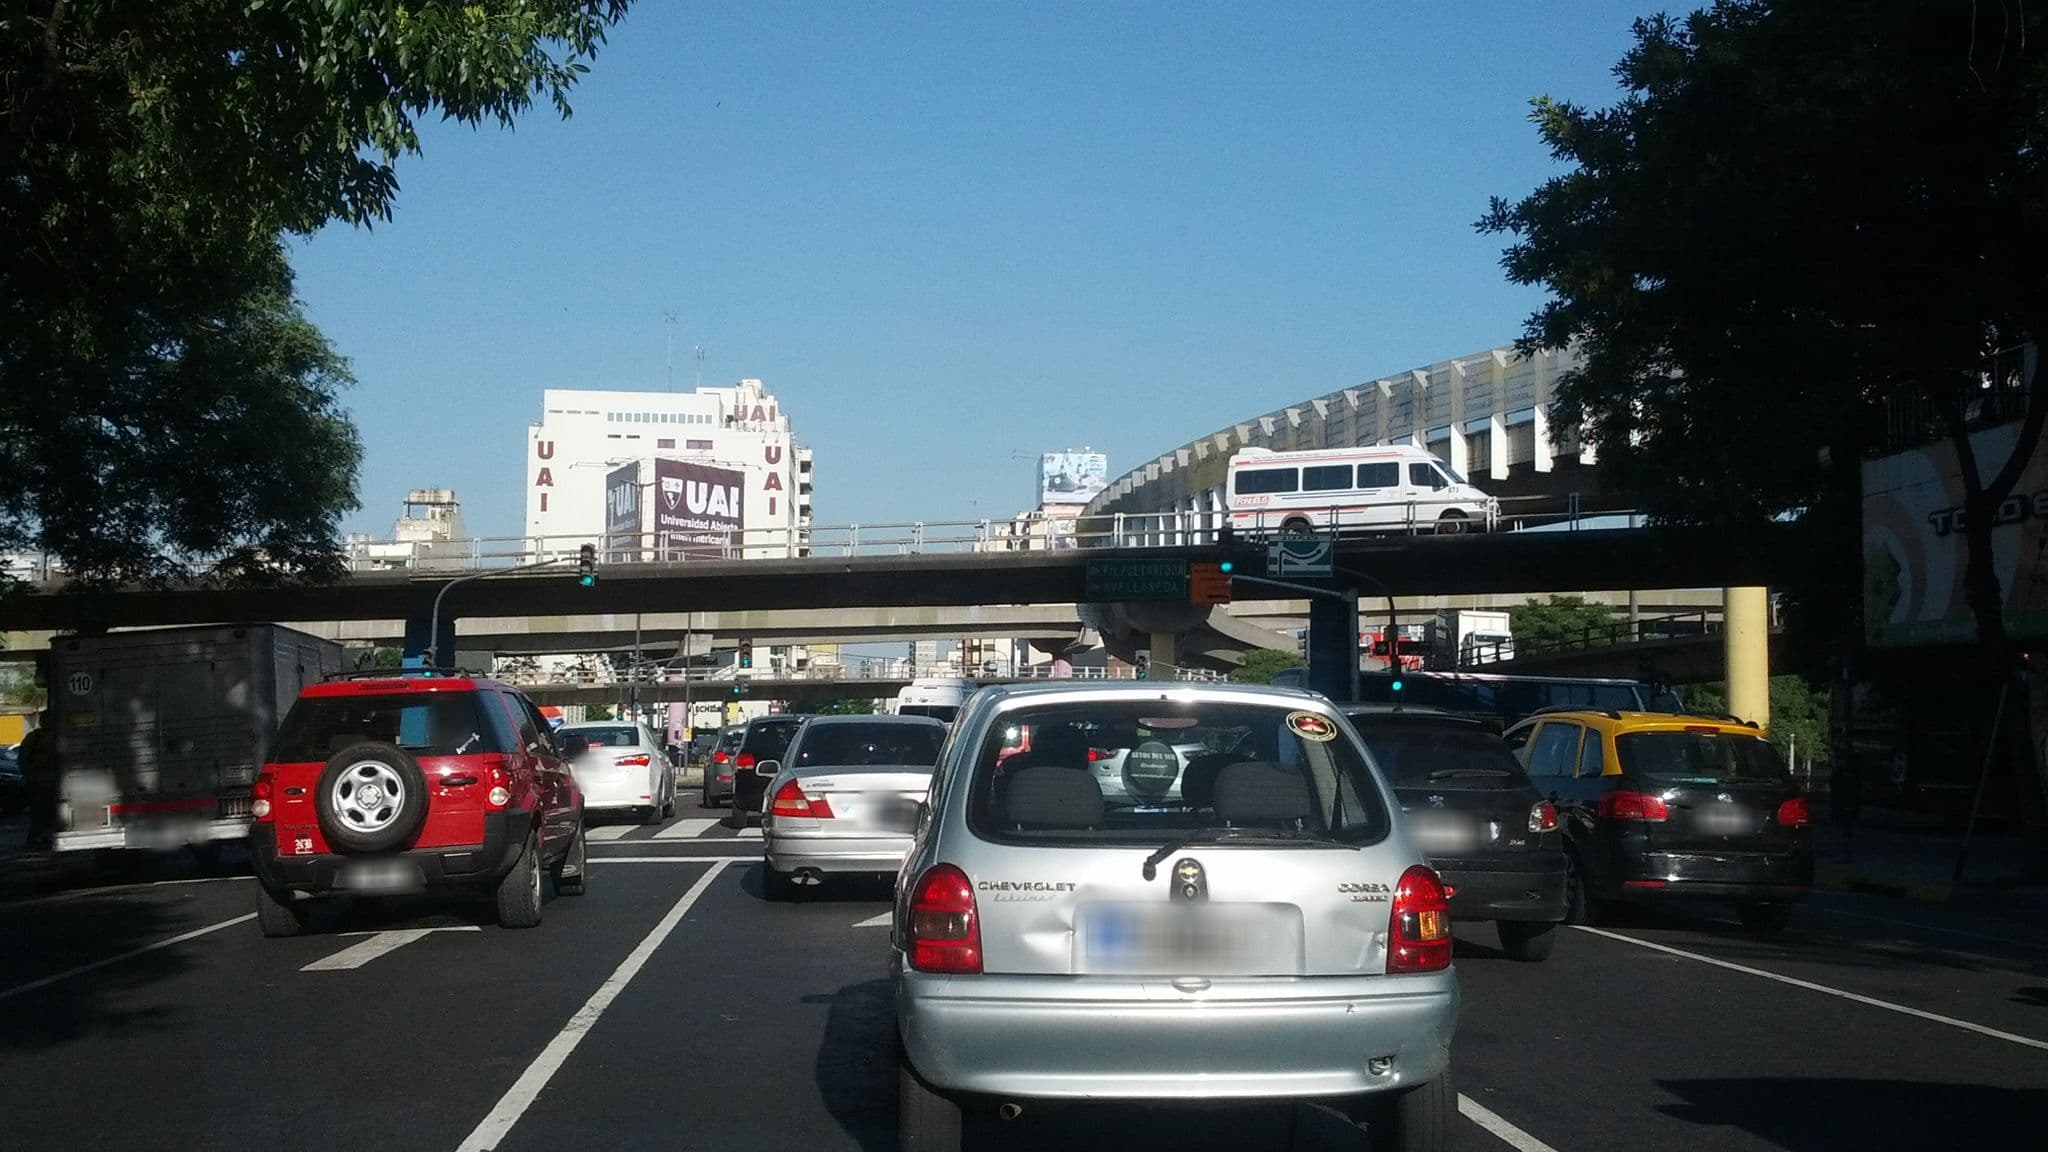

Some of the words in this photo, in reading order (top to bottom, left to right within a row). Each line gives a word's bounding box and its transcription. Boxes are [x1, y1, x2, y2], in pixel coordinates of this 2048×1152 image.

[734, 404, 776, 422] UAI
[615, 482, 636, 517] UAI
[686, 480, 739, 518] UAI
[660, 513, 709, 530] Universidad
[70, 676, 90, 691] 110
[978, 881, 1076, 892] CHEVROLET
[1338, 883, 1390, 893] CORSA
